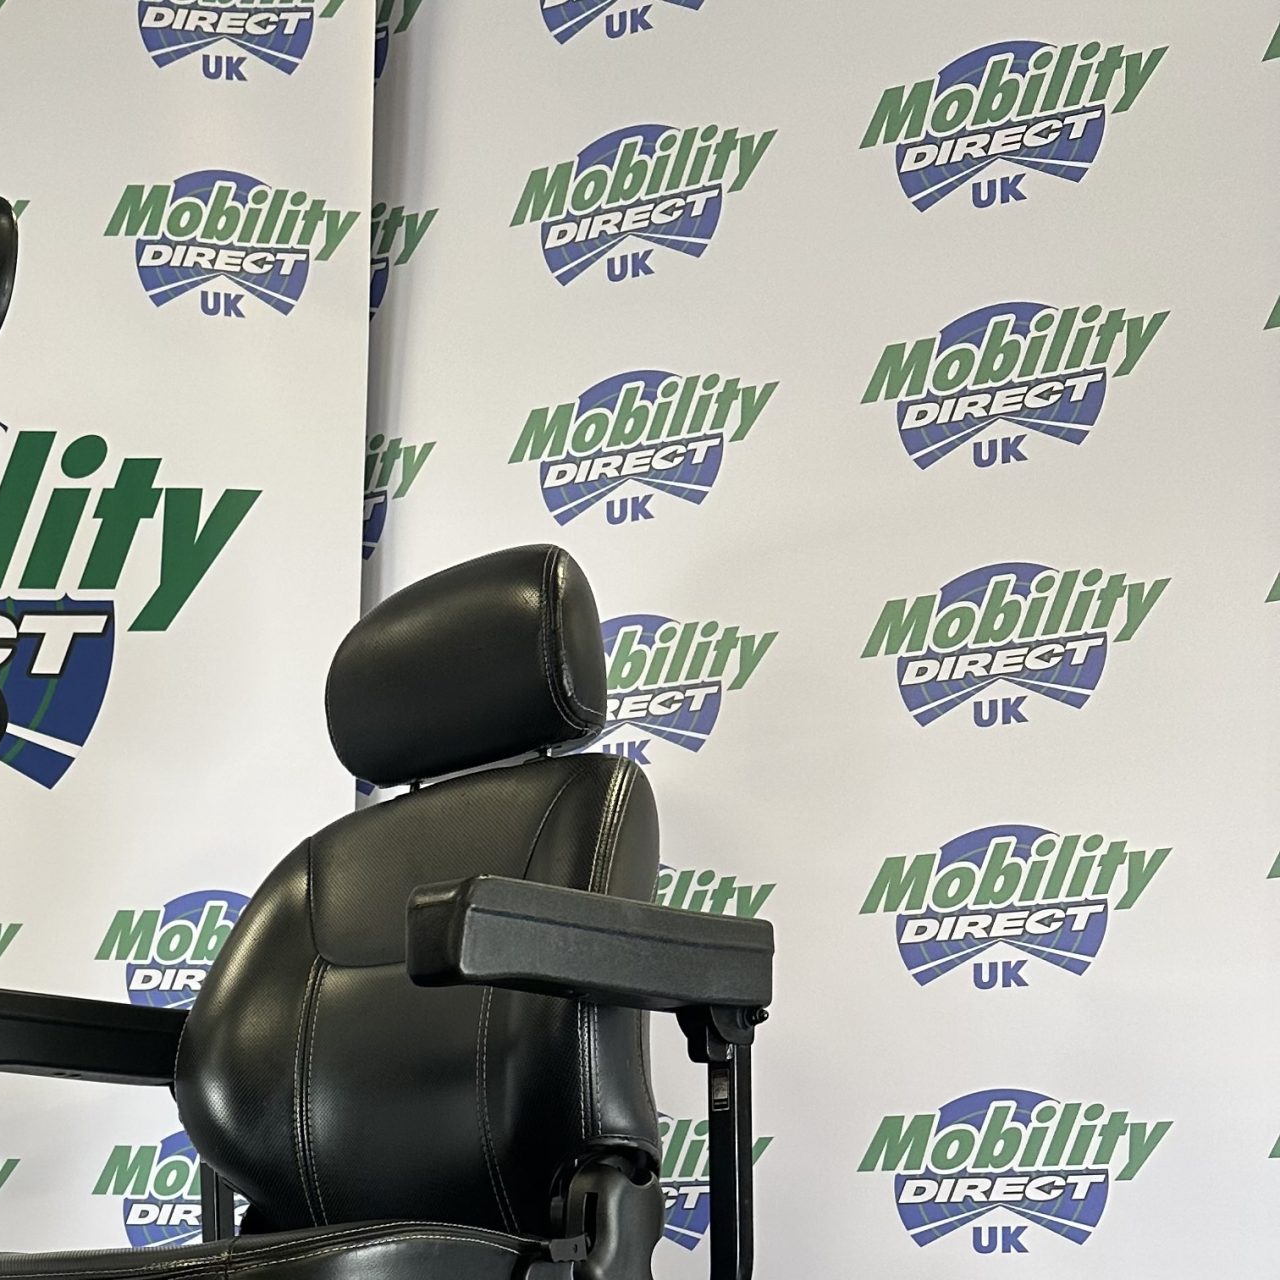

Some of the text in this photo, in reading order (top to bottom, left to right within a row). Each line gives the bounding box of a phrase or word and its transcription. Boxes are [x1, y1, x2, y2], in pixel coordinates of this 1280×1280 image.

[141, 7, 312, 34] DIRECT
[605, 4, 653, 39] UK
[202, 54, 247, 81] UK
[859, 41, 1169, 149] Mobility
[899, 109, 1102, 173] DIRECT
[511, 125, 778, 226] Mobility
[972, 173, 1028, 209] UK
[103, 184, 360, 261] Mobility
[545, 188, 718, 251] DIRECT
[138, 249, 307, 276] DIRECT
[606, 250, 654, 283] UK
[200, 290, 246, 318] UK
[860, 305, 1170, 404] Mobility
[508, 374, 780, 463] Mobility
[900, 373, 1103, 430] DIRECT
[543, 439, 719, 488] DIRECT
[973, 434, 1028, 468] UK
[606, 495, 654, 525] UK
[860, 568, 1171, 658] Mobility
[606, 620, 779, 691] bility
[901, 638, 1104, 686] DIRECT
[973, 695, 1028, 728] UK
[859, 834, 1172, 915] Mobility
[899, 904, 1104, 944] DIRECT
[973, 959, 1028, 990] UK
[856, 1103, 1174, 1181] Mobility
[898, 1174, 1105, 1204] DIRECT
[972, 1226, 1029, 1254] UK
